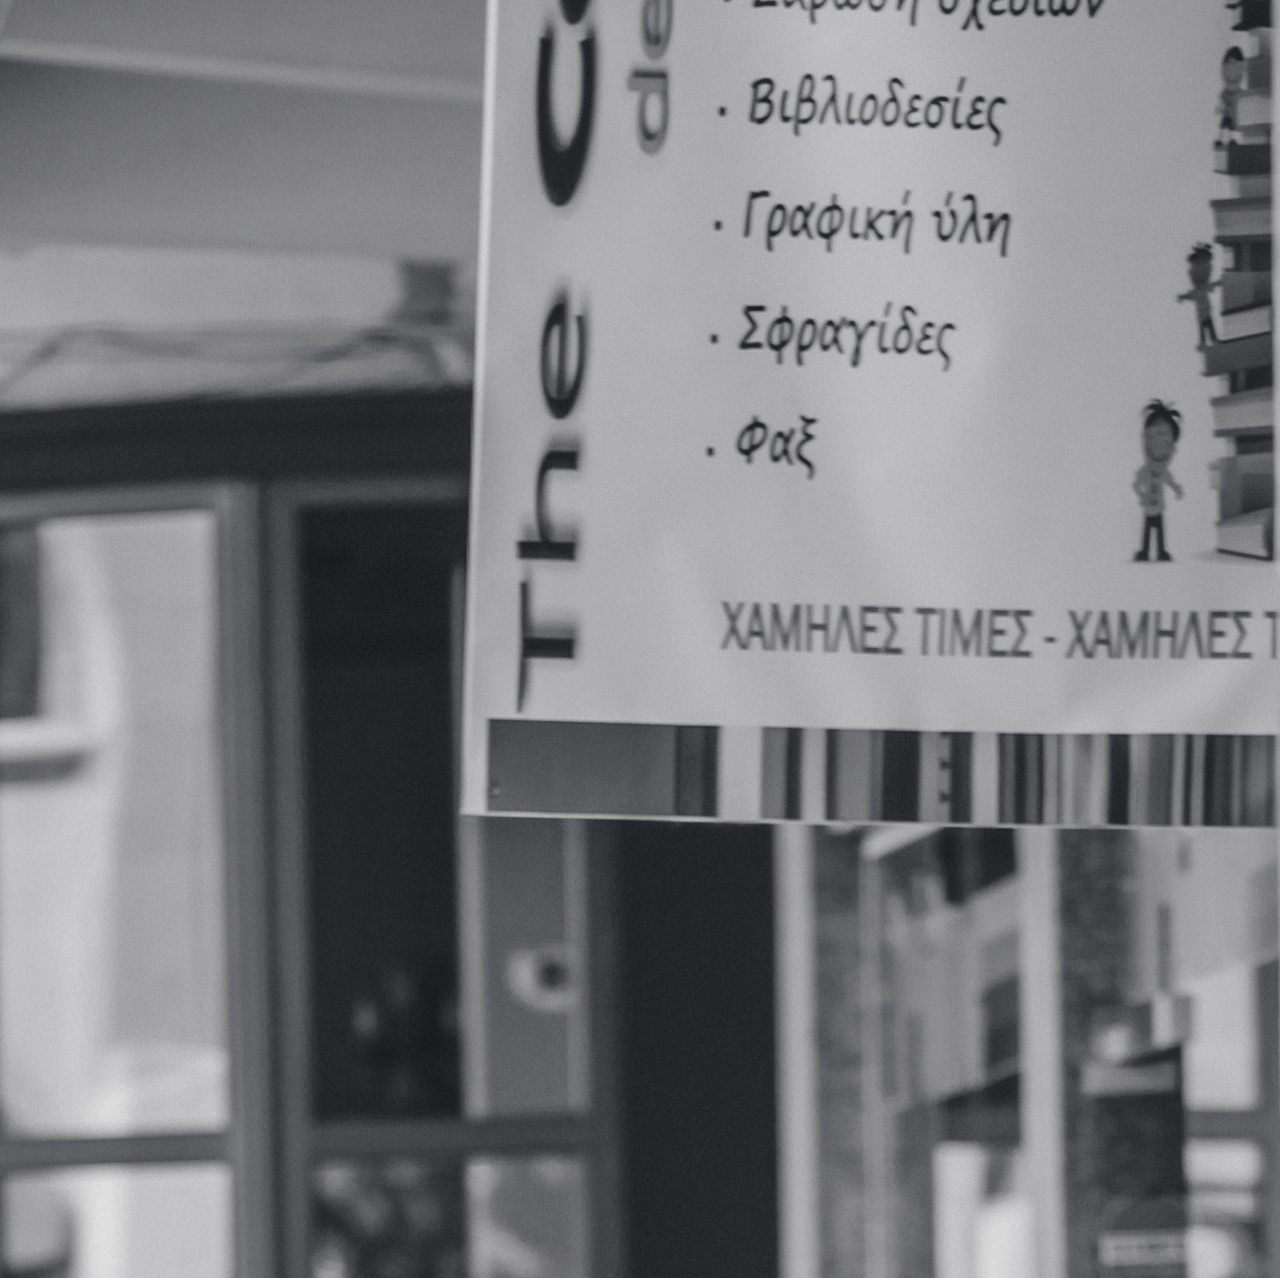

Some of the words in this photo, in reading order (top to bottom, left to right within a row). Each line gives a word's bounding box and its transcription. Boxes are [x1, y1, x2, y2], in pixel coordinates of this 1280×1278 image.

[534, 0, 598, 207] C
[748, 73, 1008, 147] Βιβλιοδεσίες
[742, 189, 914, 253] Γραφική
[931, 191, 1012, 258] ύλη
[737, 302, 956, 372] Σφραγίδες
[736, 415, 818, 480] Φαξ
[515, 288, 588, 714] The
[721, 600, 904, 656] ΧΑΜΗΛΕΣ
[914, 606, 1034, 659] ΤΙΜΕΣ
[1065, 609, 1253, 660] ΧΑΜΗΛΕΣ
